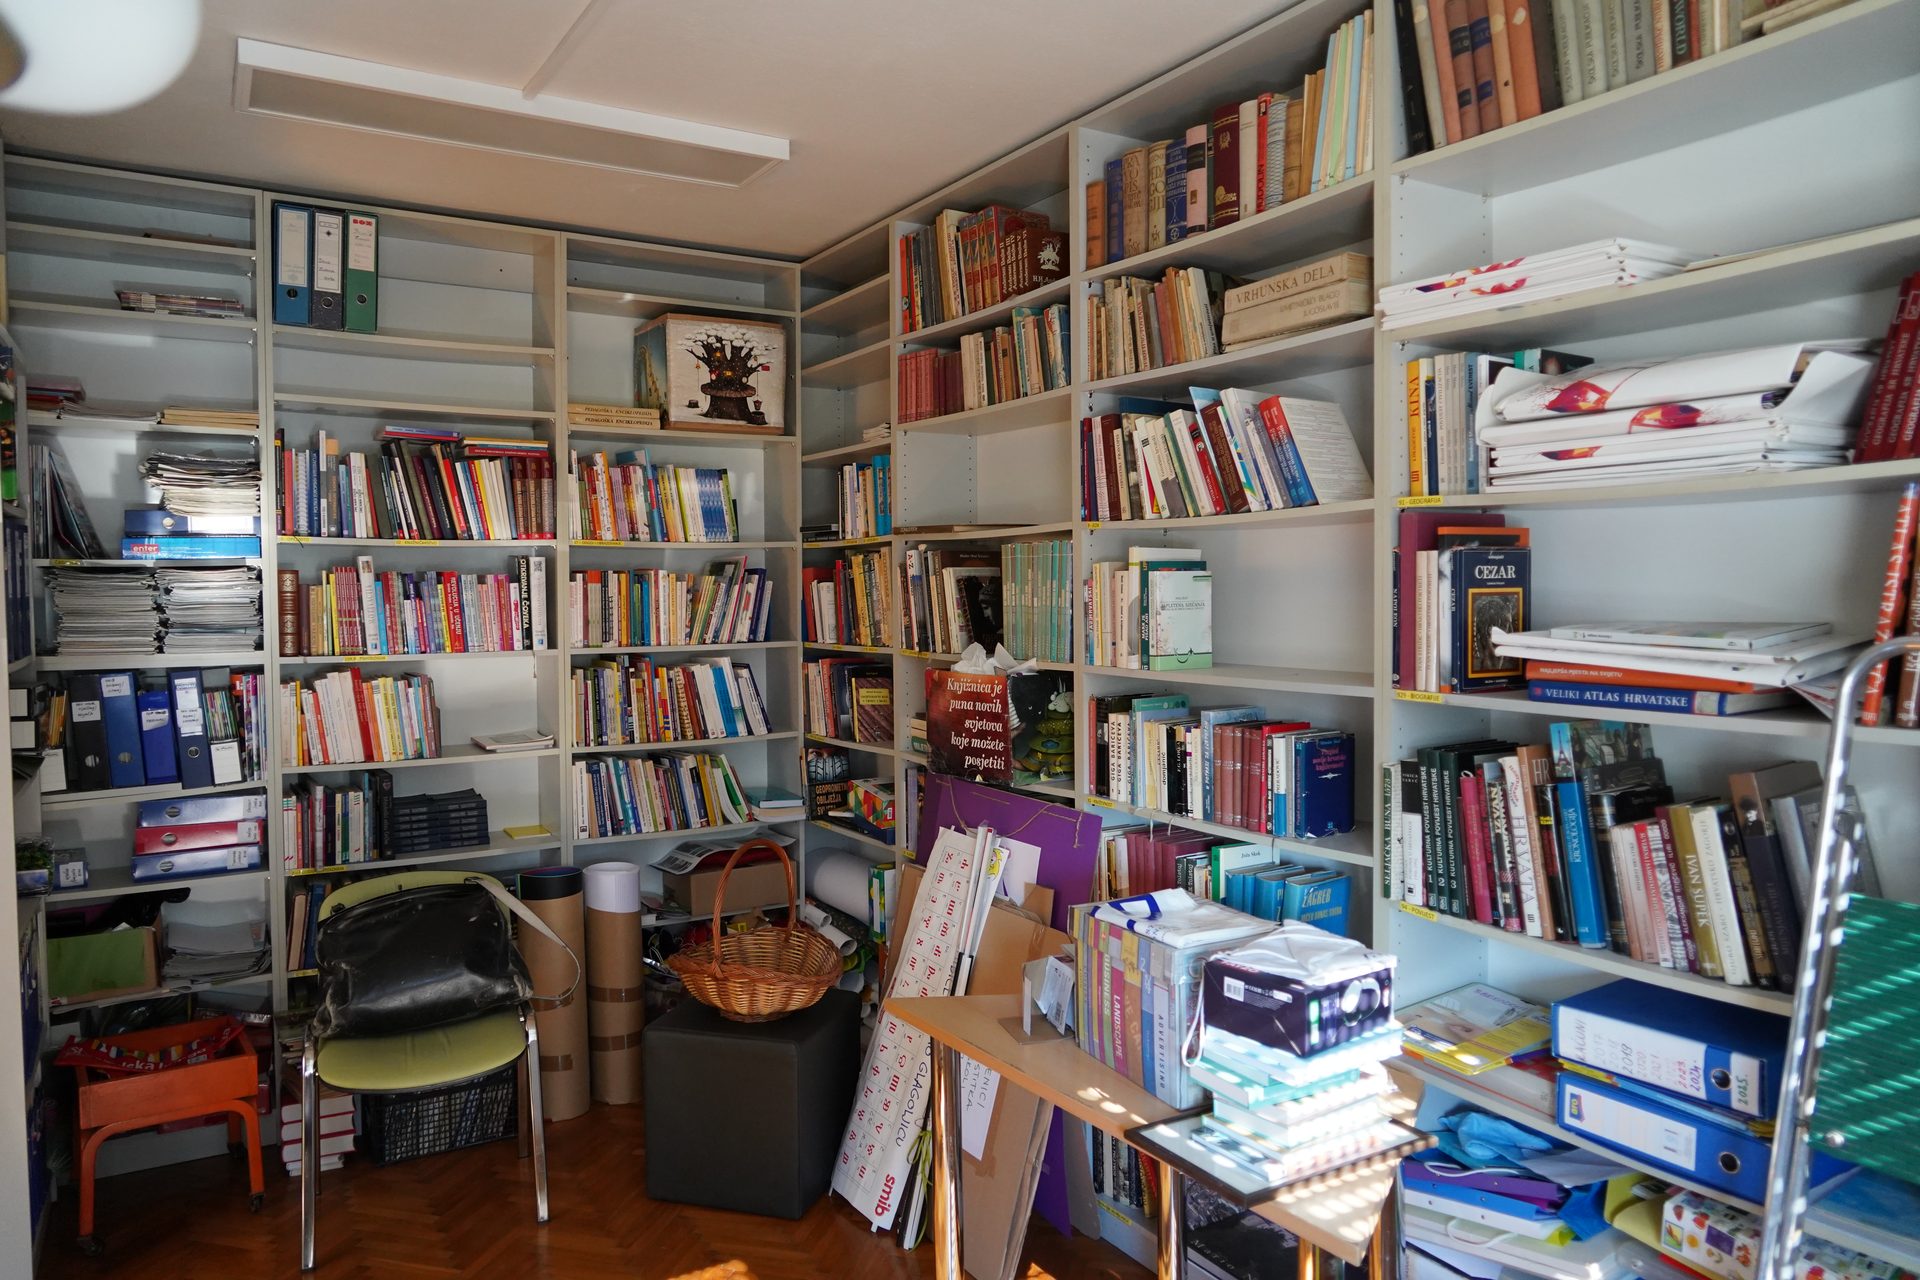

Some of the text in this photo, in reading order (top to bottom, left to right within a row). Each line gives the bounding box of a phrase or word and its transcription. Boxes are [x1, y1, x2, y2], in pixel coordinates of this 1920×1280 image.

[1236, 265, 1335, 304] VRHUNSKA DELA
[1408, 376, 1420, 417] KINA
[132, 544, 158, 553] enter
[1474, 565, 1516, 580] CEZAR
[450, 576, 458, 609] REVOLUCIJA
[520, 558, 530, 629] OTKRIVANJE ČOVEKA
[947, 678, 1003, 698] Knjižnica je
[1546, 688, 1688, 707] VELIKI ATLAS HRVATSKE
[949, 699, 1003, 713] puna novih
[951, 731, 1005, 751] koje možete
[964, 717, 1004, 733] svjetova
[964, 754, 1005, 771] posjetiti
[815, 784, 848, 794] GEOPROMETN
[1420, 766, 1428, 801] HRVATSKE
[1430, 768, 1438, 802] HRVATSKE
[1443, 770, 1451, 805] HRVATSKE
[1423, 801, 1431, 834] POVIJEST
[1432, 803, 1441, 836] POVIJEST
[1445, 806, 1453, 839] POVIJEST
[1424, 835, 1433, 872] KULTURNA
[1434, 836, 1443, 874] KULTURNA
[1446, 840, 1456, 877] KULTURNA
[1513, 815, 1536, 904] HRVATA
[1302, 888, 1332, 908] ZAGREB
[1686, 854, 1710, 927] IVAN SUPEK
[1710, 865, 1723, 904] HRVATSKO
[1113, 994, 1123, 1059] LANDSCAPE
[1622, 1043, 1633, 1074] 2019
[874, 1172, 896, 1218] smib
